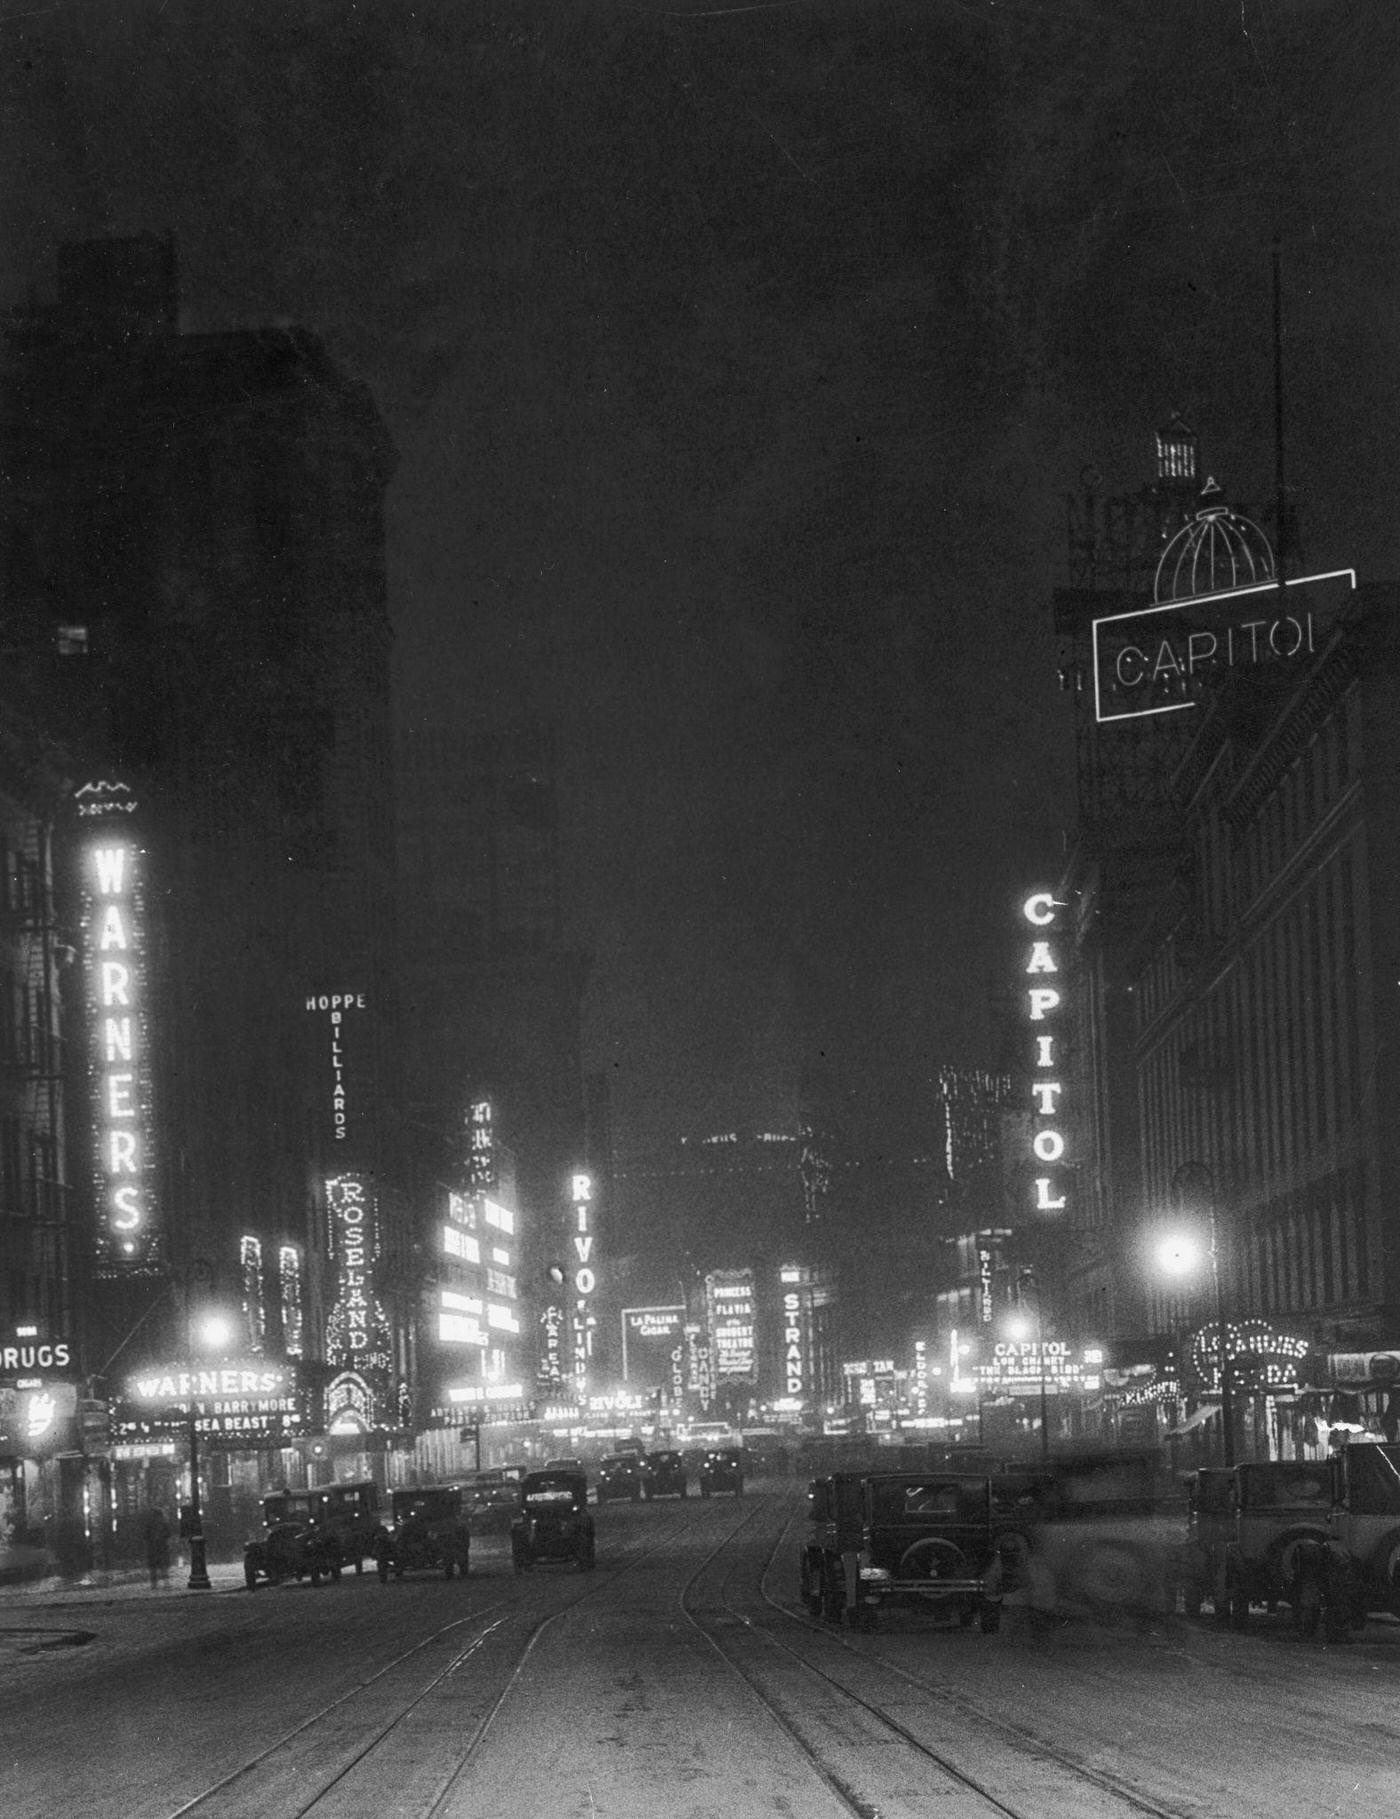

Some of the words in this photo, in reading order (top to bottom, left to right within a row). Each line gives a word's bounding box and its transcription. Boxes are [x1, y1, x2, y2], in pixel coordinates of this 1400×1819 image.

[306, 994, 366, 1010] HOPPE
[1023, 891, 1067, 1211] CAPITOL
[331, 1011, 345, 1140] BILLIARDS
[340, 1181, 369, 1350] ROSELAND
[714, 1286, 752, 1298] PRINCESS
[716, 1303, 751, 1314] FLAVIA
[641, 1326, 671, 1336] CIGAR
[783, 1294, 802, 1394] STRAND
[995, 1342, 1071, 1356] CAPITOL
[698, 1347, 710, 1411] CANDY
[214, 1398, 296, 1415] BARRYMORE
[194, 1417, 220, 1432] SEA
